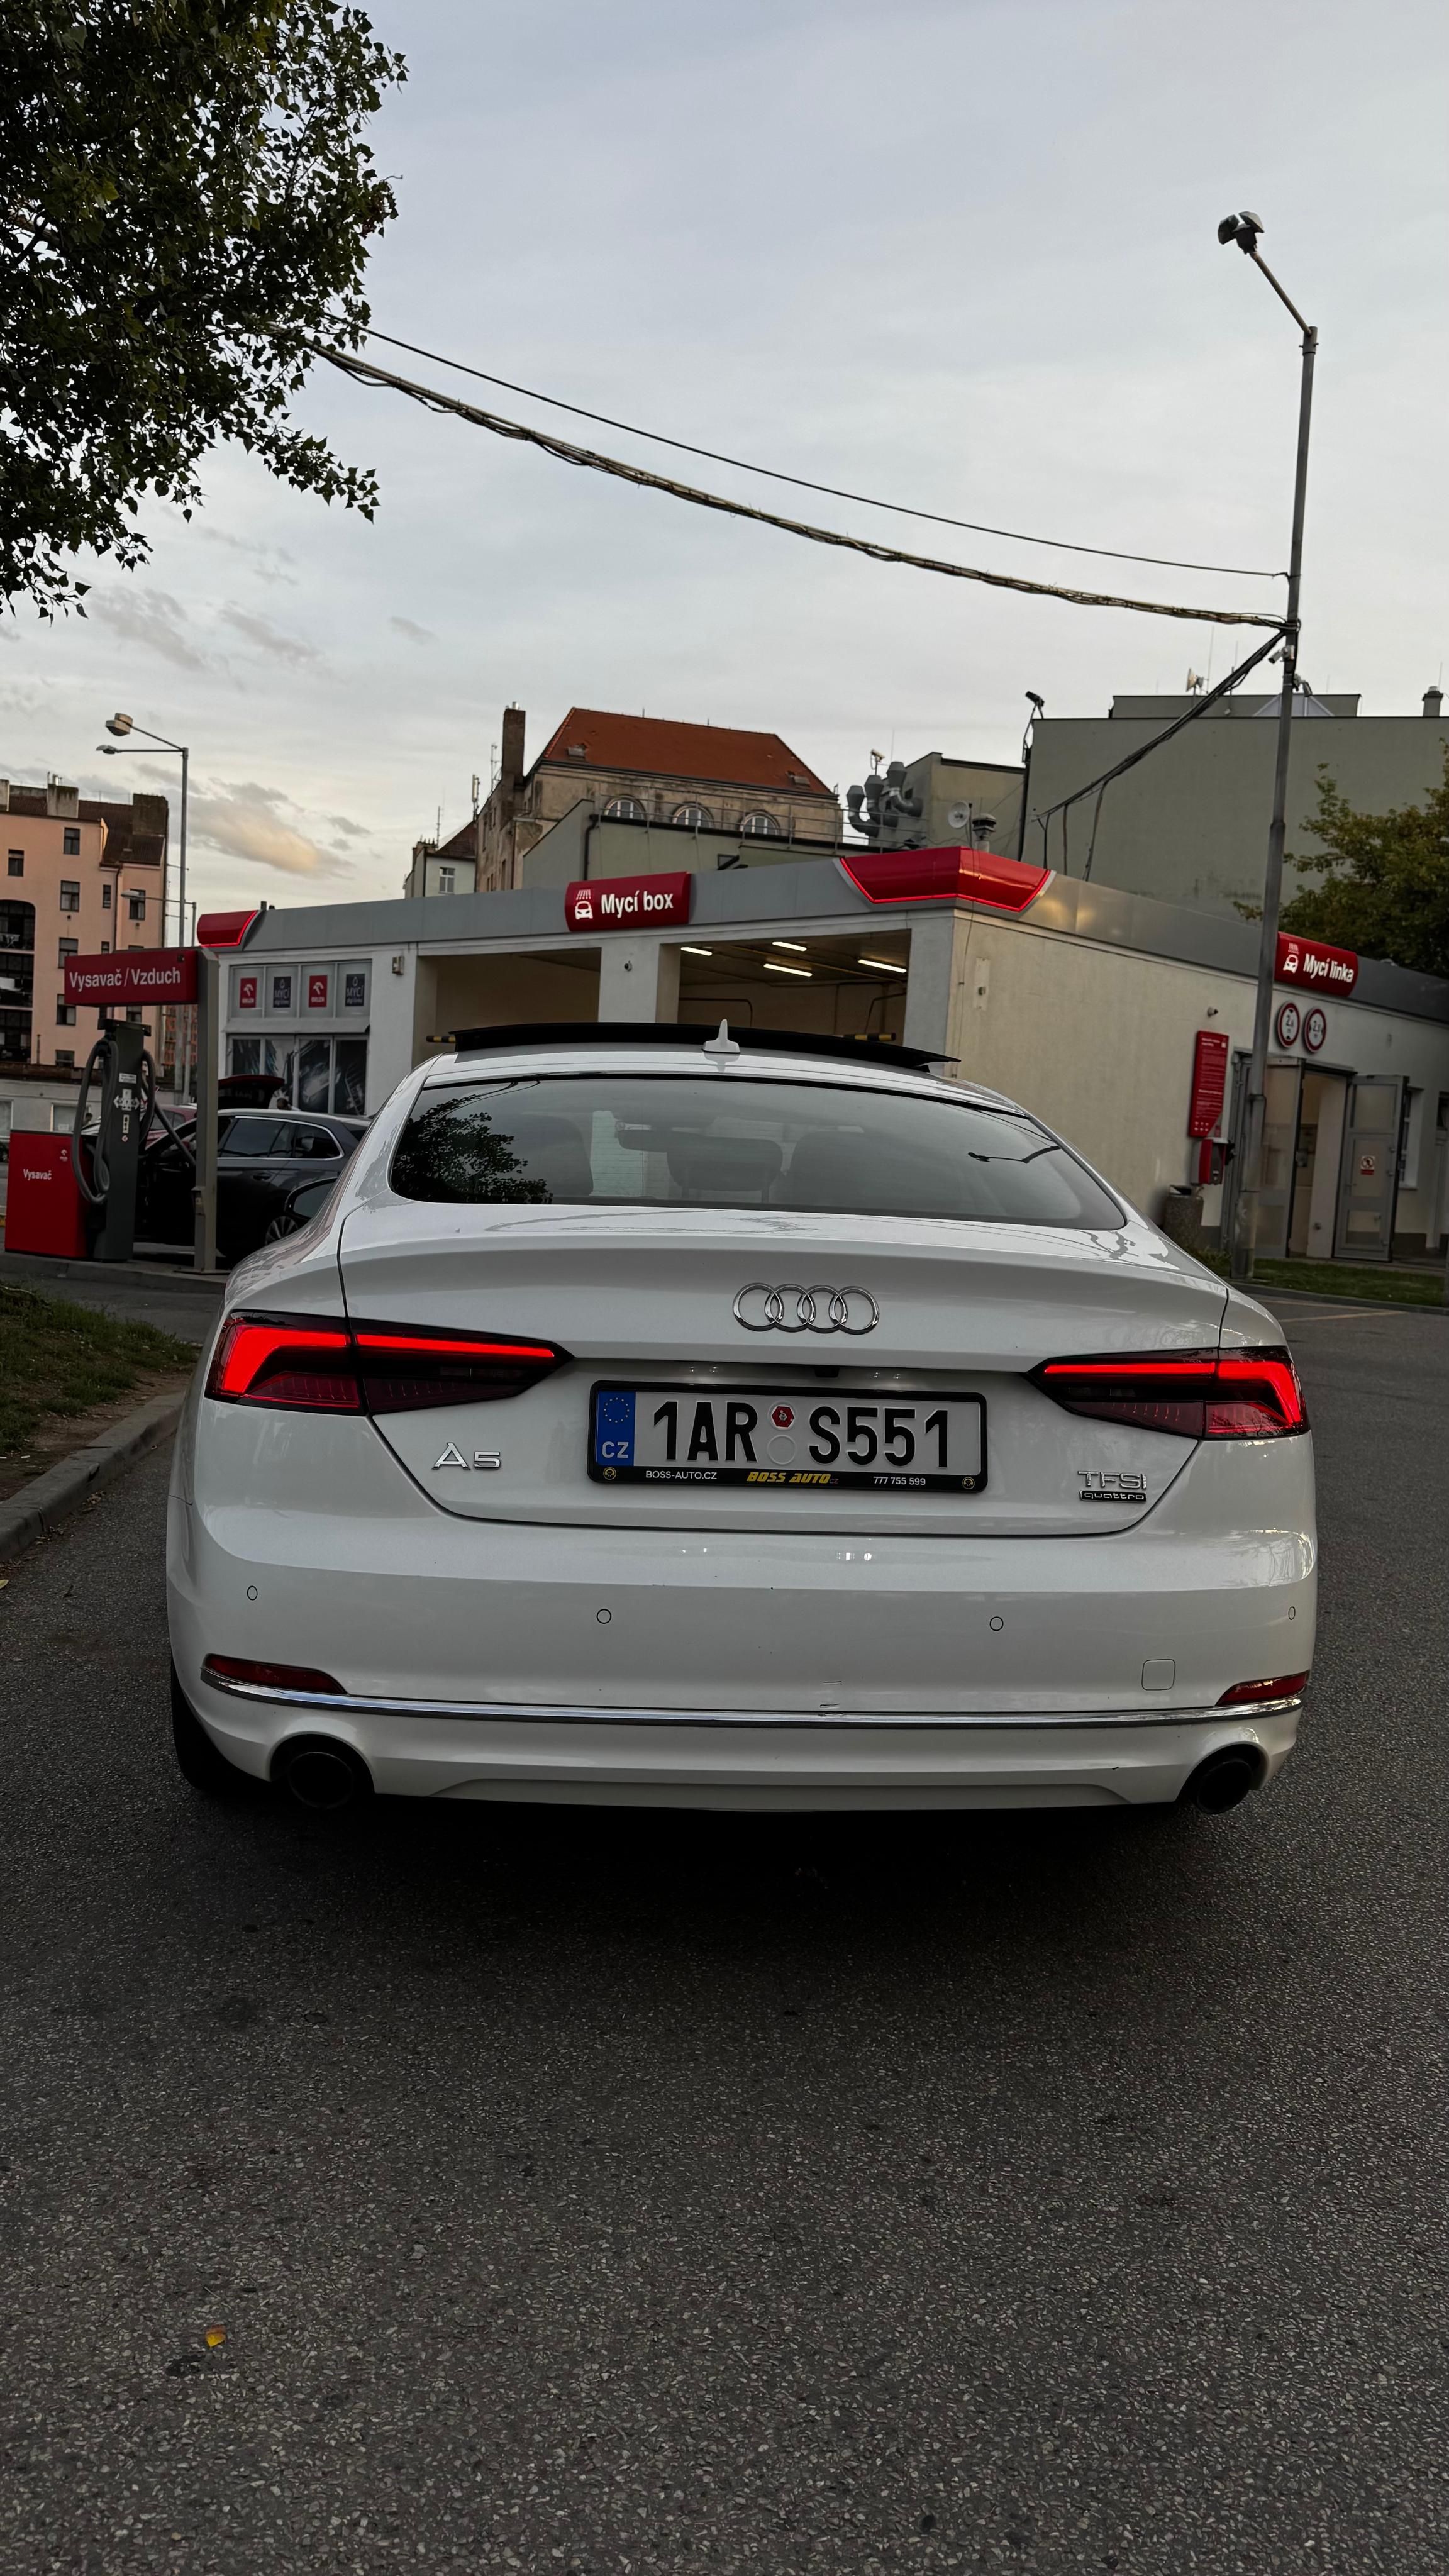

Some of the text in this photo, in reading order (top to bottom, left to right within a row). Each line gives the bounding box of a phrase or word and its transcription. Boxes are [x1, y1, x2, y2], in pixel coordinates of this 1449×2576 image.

[601, 890, 674, 919] Mycí box
[1303, 953, 1354, 983] Mycí linka
[69, 969, 122, 992] Vysavač
[131, 967, 181, 985] Vzduch
[23, 1169, 52, 1181] Vysavač
[653, 1401, 949, 1468] 1AR S551
[431, 1442, 501, 1470] A5
[601, 1441, 629, 1459] CZ
[645, 1470, 718, 1480] BOSS-AUTO.CZ
[747, 1472, 787, 1482] BOSS
[789, 1473, 831, 1484] AUTO
[873, 1476, 926, 1485] 777 755 599
[1077, 1470, 1147, 1489] TFSI
